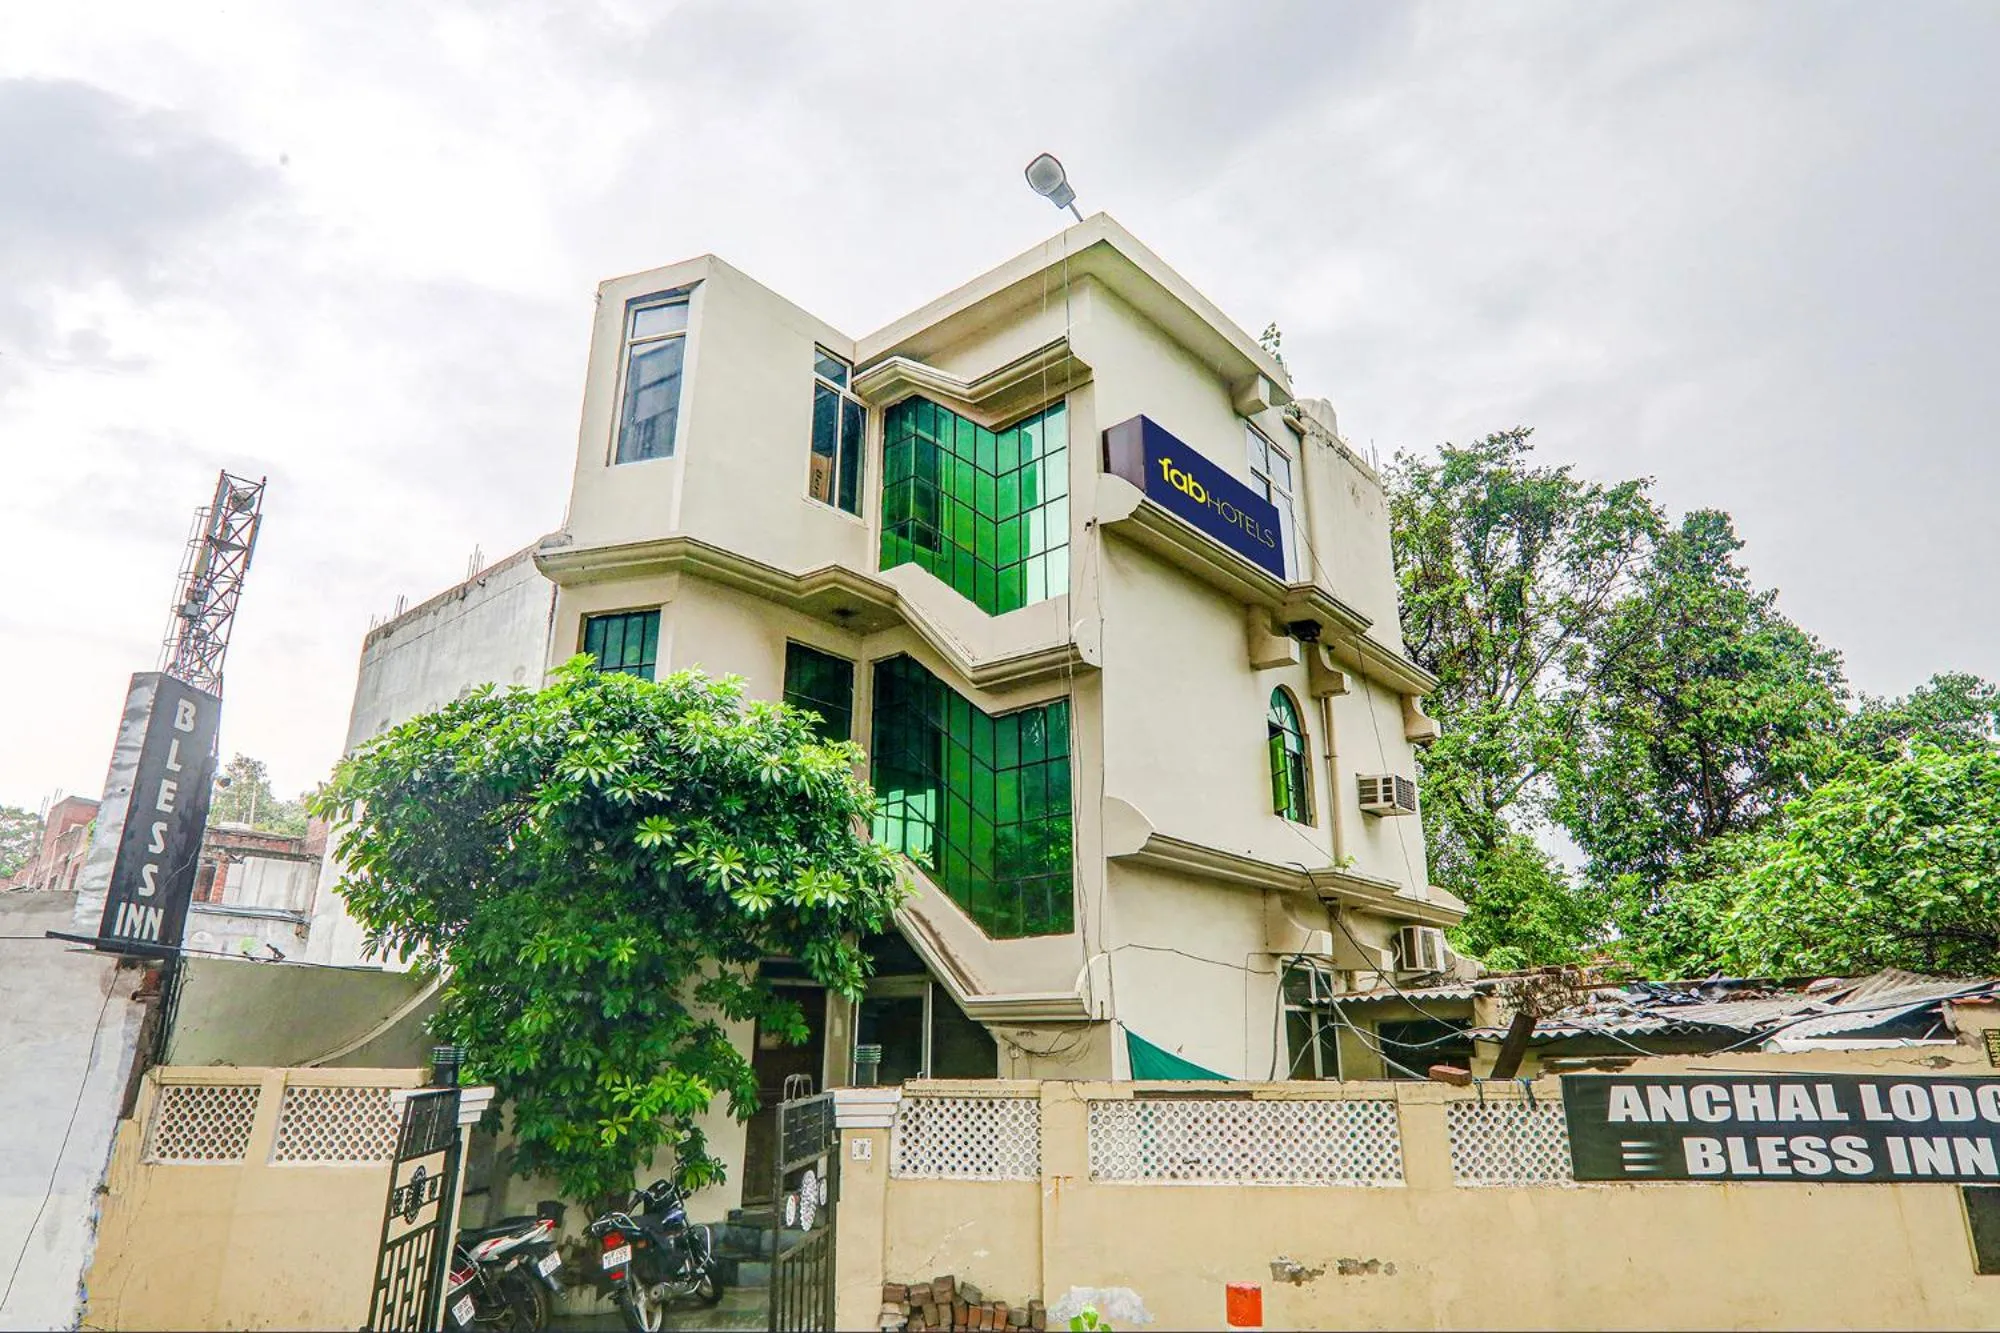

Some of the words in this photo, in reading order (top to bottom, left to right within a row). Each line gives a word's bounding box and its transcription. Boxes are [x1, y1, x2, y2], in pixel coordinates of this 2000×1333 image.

[138, 698, 197, 897] BLESS
[113, 902, 164, 941] INN
[1607, 1083, 1849, 1123] ANCHAL
[1682, 1135, 1874, 1176] BLESS
[1885, 1136, 1999, 1175] INN
